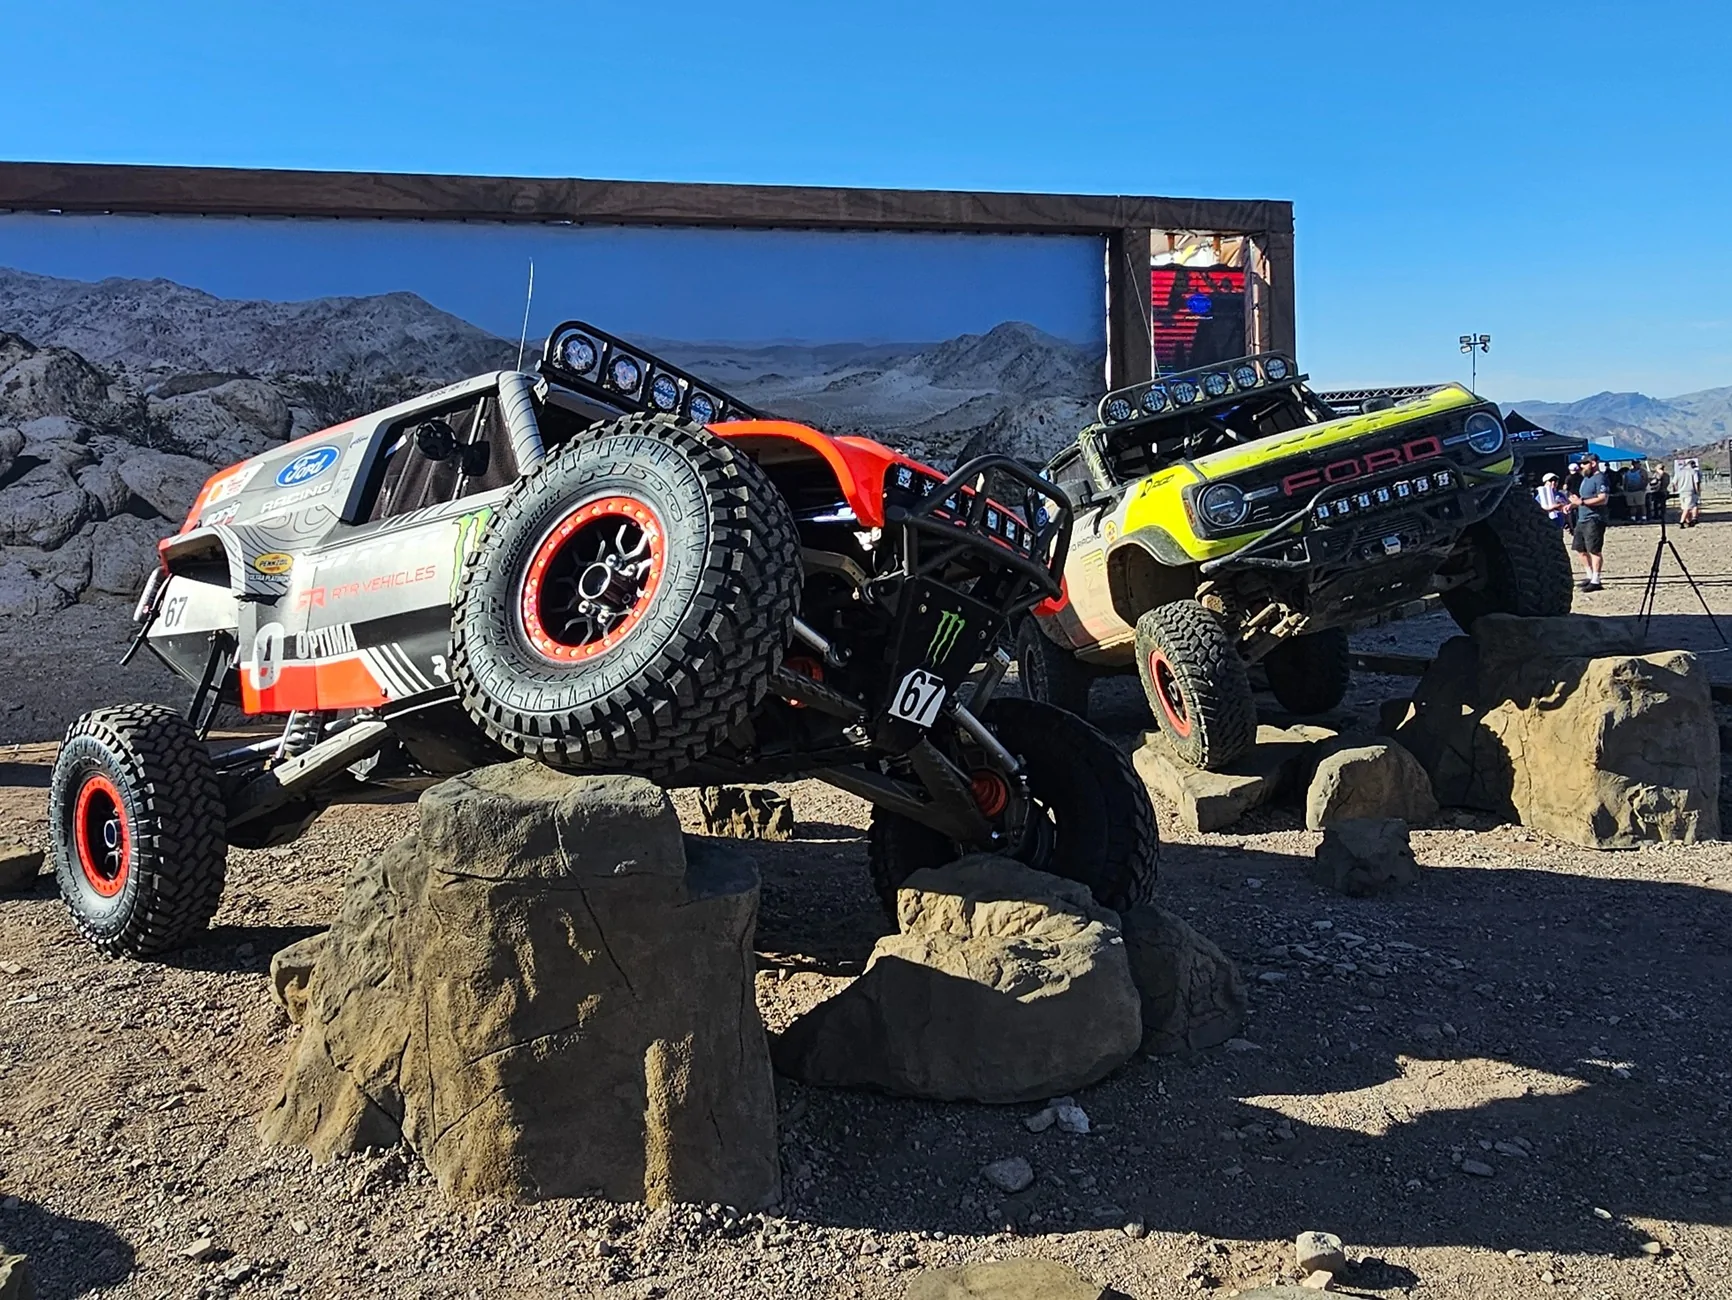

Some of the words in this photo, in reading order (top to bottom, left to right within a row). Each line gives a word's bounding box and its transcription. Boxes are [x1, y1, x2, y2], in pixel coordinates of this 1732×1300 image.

[285, 452, 329, 483] Ford
[1283, 435, 1442, 496] FORD
[260, 481, 333, 514] RACING
[258, 558, 289, 567] PENNZOIL
[362, 565, 436, 592] VEHICLES
[165, 596, 188, 628] 67
[296, 623, 358, 659] OPTIMA
[899, 671, 944, 722] 67
